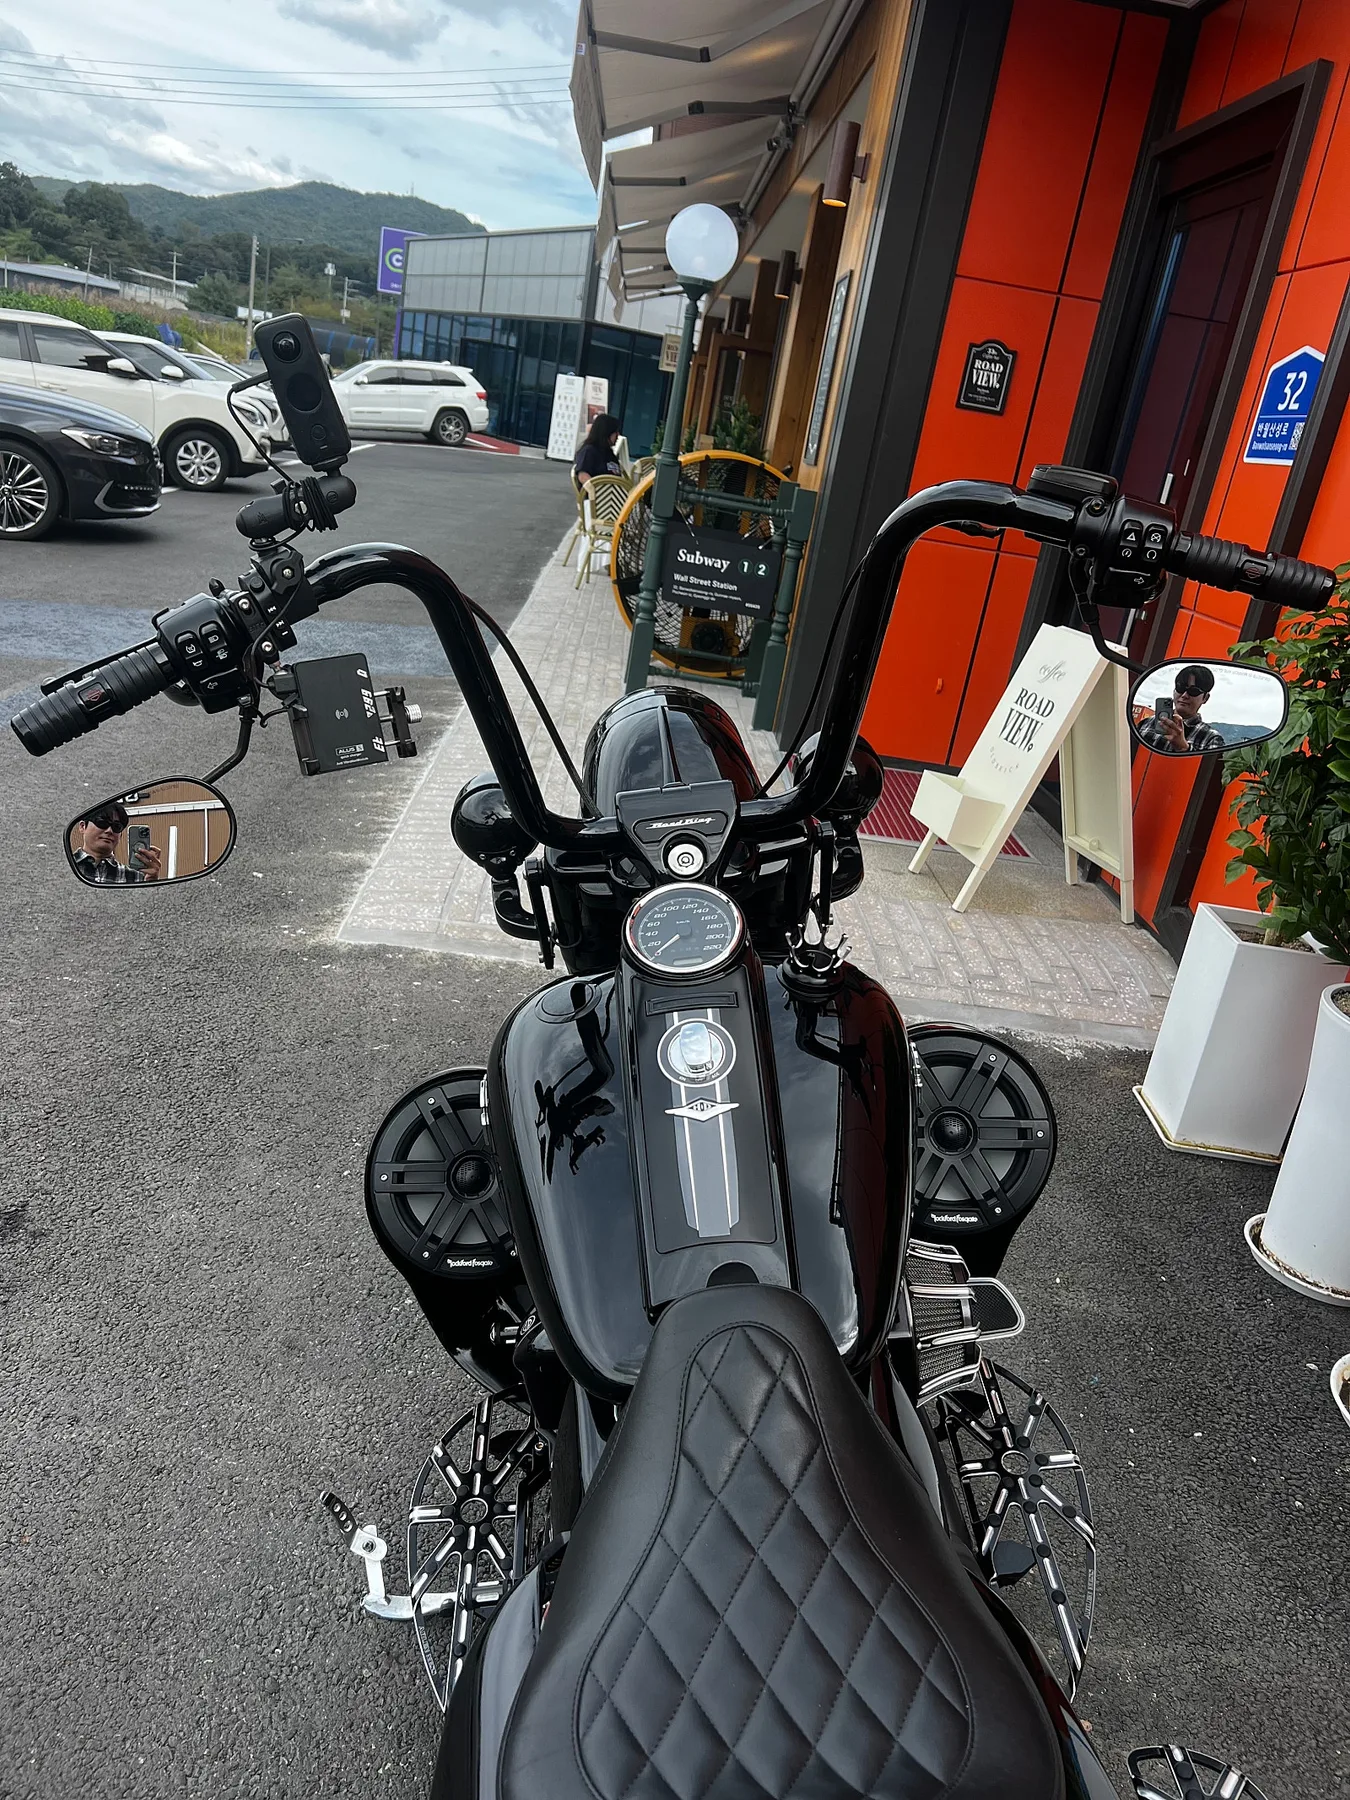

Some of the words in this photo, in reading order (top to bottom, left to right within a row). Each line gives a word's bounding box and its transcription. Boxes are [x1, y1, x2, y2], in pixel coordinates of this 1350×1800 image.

[974, 358, 1004, 374] ROAD
[1277, 370, 1308, 411] 32
[676, 548, 731, 573] Subway
[673, 572, 689, 583] Wall
[689, 576, 712, 588] Street
[712, 580, 738, 592] Station
[1038, 660, 1066, 684] coffee
[1014, 686, 1056, 719] ROAD
[998, 707, 1044, 752] VIEW
